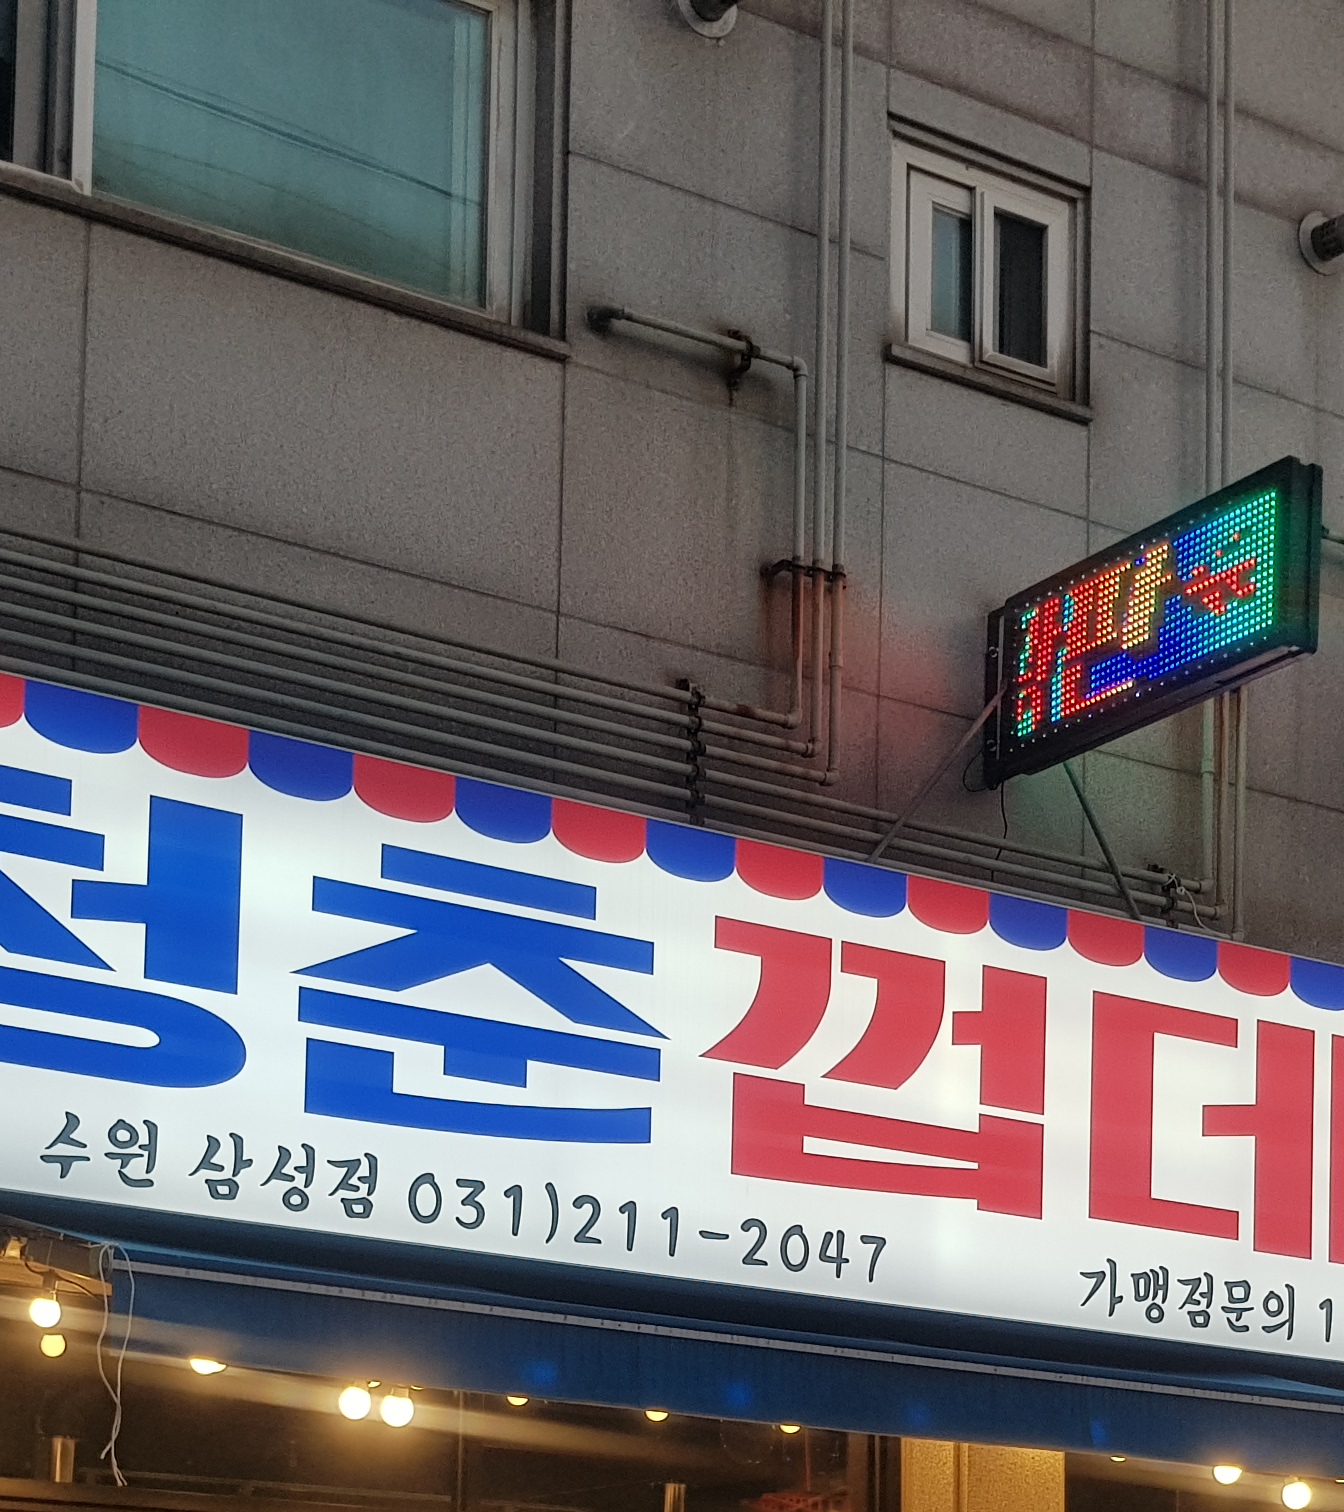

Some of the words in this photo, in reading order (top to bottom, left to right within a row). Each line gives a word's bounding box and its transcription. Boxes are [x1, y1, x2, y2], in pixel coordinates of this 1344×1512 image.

[39, 1112, 160, 1189] 수원
[189, 1133, 382, 1218] 삼성점
[409, 1172, 888, 1283] 031)211-2047
[1078, 1257, 1298, 1344] 가맹점문의
